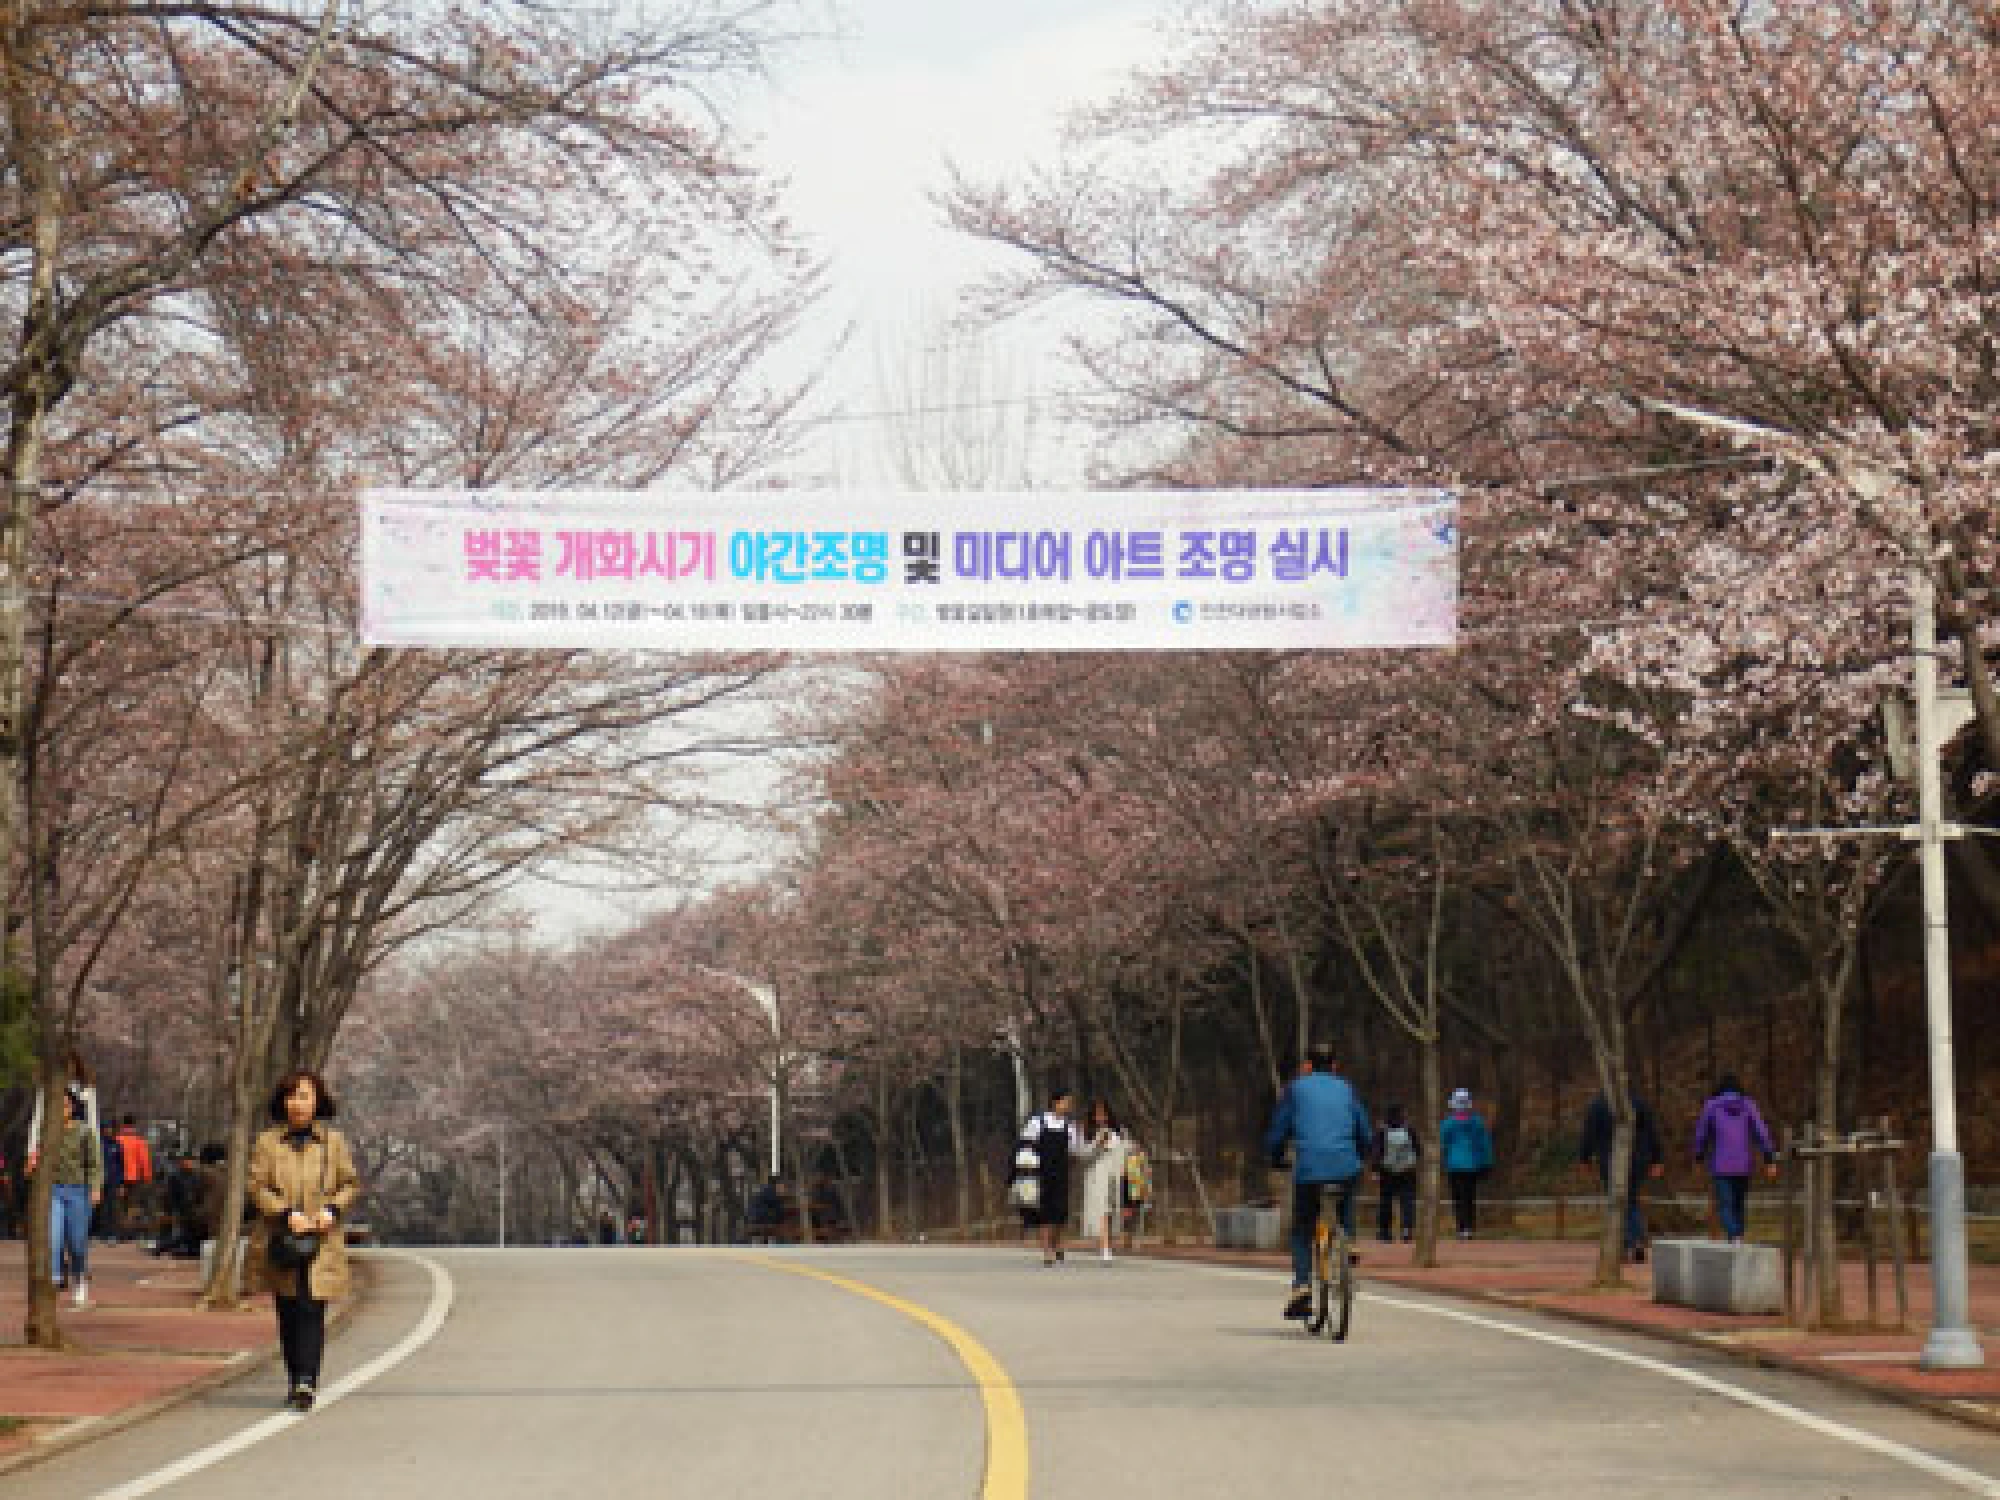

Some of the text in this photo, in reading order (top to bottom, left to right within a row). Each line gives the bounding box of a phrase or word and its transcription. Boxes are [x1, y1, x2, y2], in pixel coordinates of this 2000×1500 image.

[464, 528, 1349, 584] 벚꽃 개화시기 야간조명 및 미디어 아트 조명 실시
